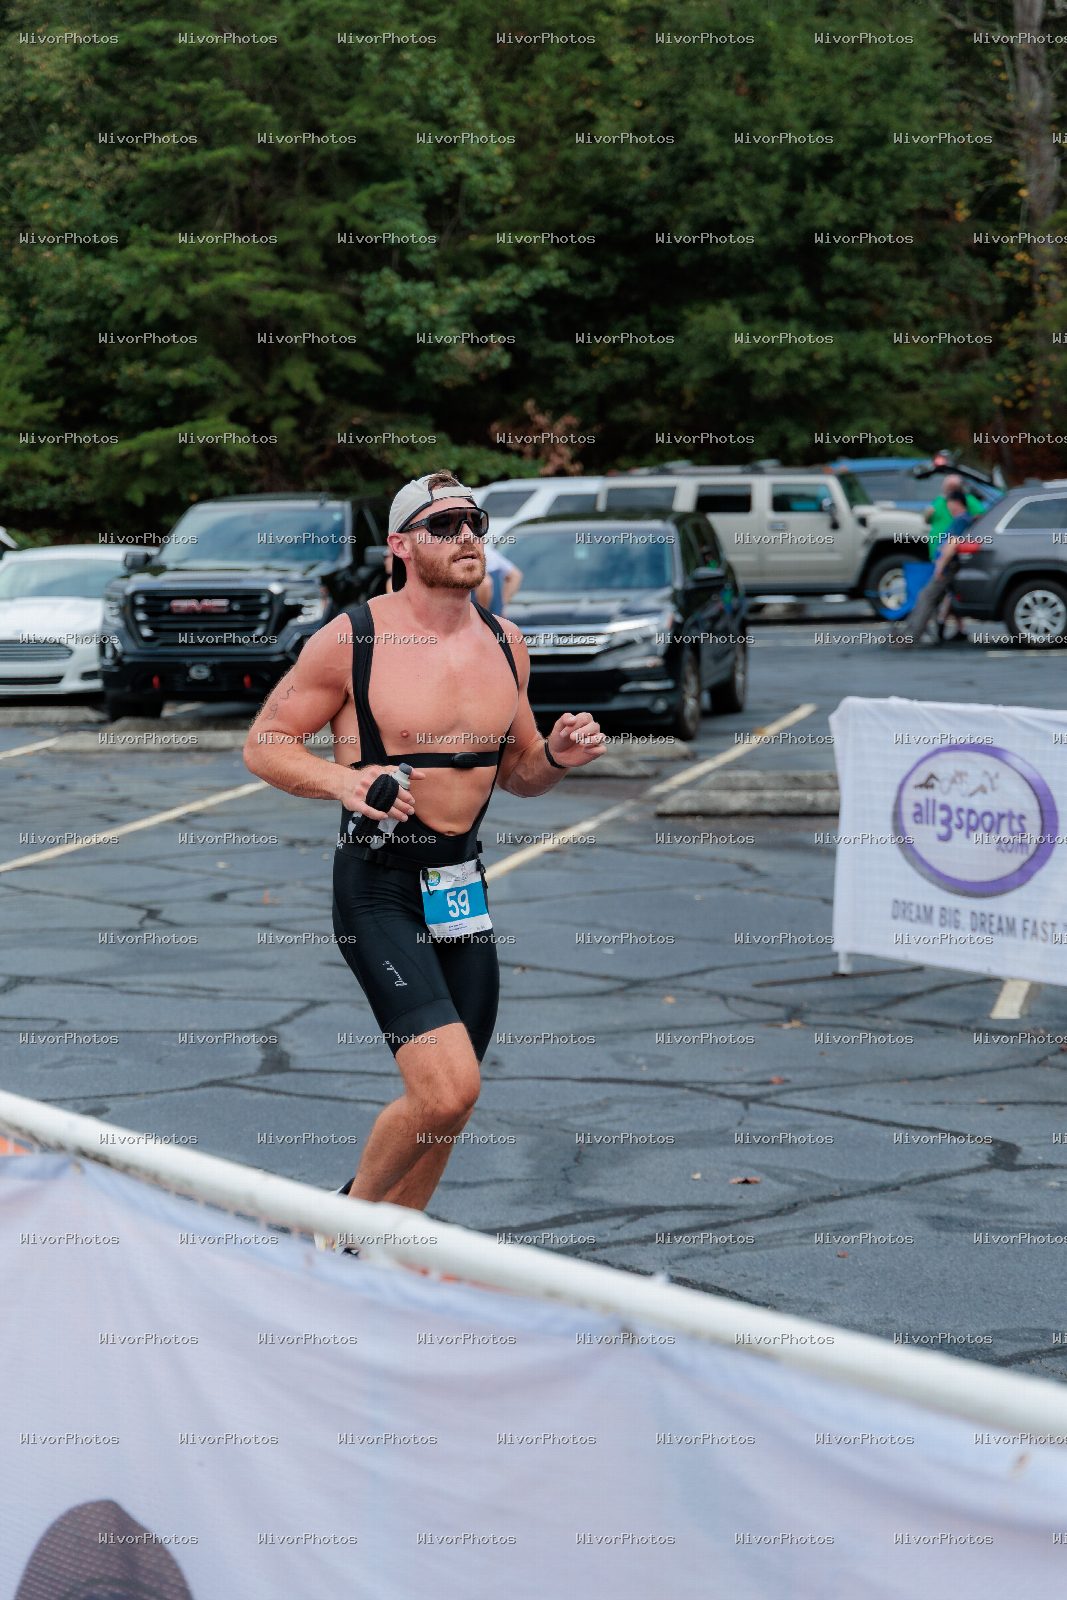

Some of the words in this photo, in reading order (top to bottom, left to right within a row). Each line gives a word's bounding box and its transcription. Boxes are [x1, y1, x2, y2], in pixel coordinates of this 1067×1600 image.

[446, 889, 471, 918] 59
[891, 899, 934, 925] DREAM
[970, 911, 1017, 937] DREAM
